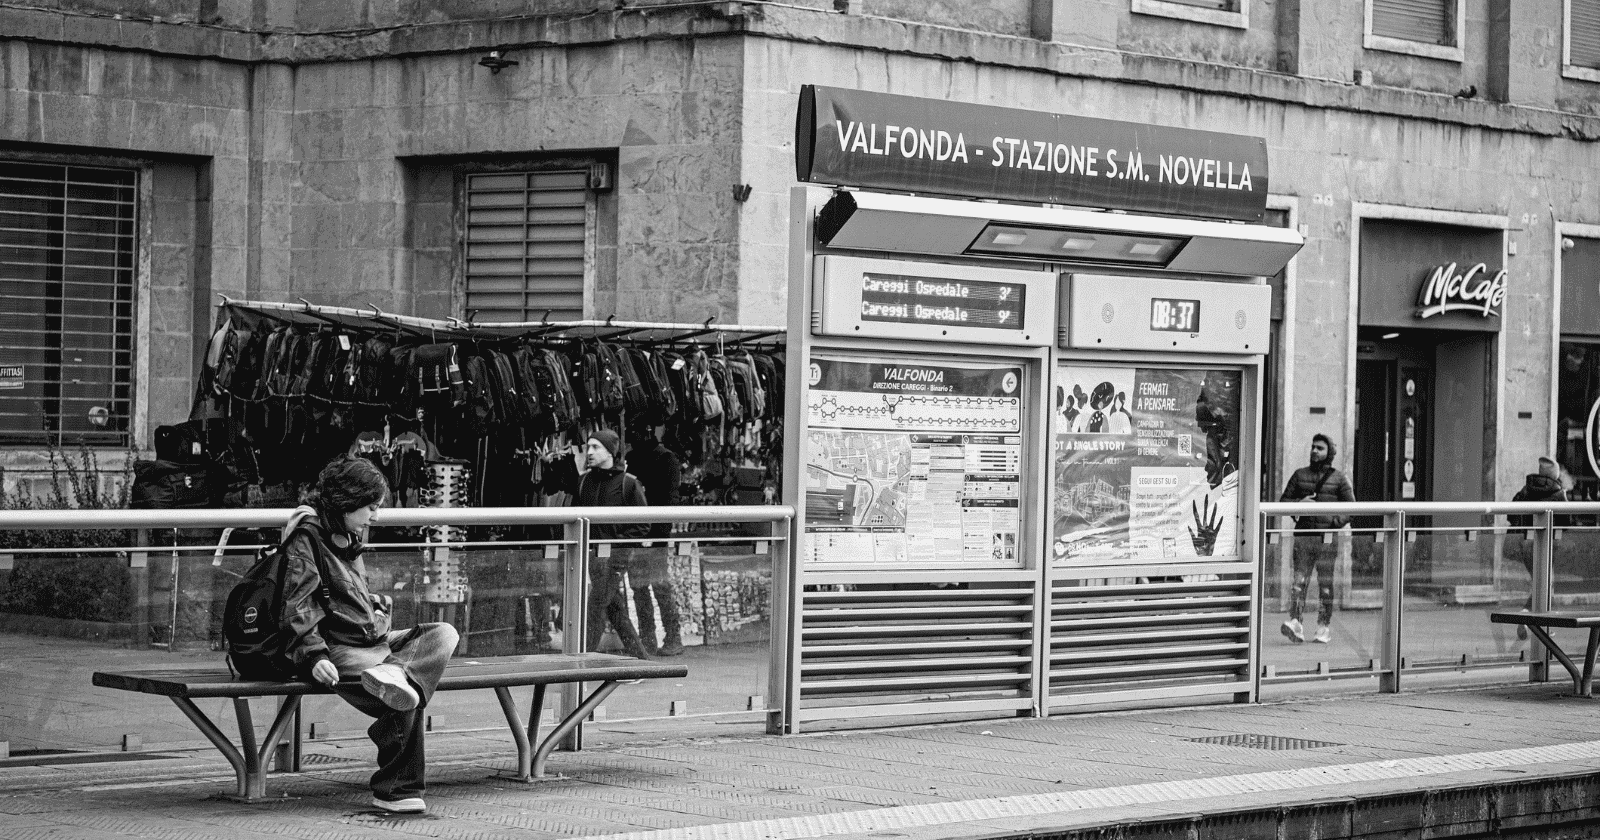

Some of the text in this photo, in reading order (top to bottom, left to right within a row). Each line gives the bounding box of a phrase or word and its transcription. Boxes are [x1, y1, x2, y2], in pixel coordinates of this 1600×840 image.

[836, 119, 968, 163] VALFONDA
[991, 136, 1098, 177] STAZIONE
[1105, 148, 1150, 182] S.M.
[1158, 155, 1253, 192] NOVELLA
[862, 277, 909, 293] Careggi
[916, 280, 969, 297] Ospedale
[1424, 262, 1508, 317] McCafé
[861, 301, 908, 317] Careggi
[914, 304, 968, 321] Ospedale
[1152, 300, 1194, 329] 08:37
[810, 367, 818, 378] T1
[884, 367, 944, 382] VALFONDA
[873, 382, 901, 390] DIREZIONE
[901, 383, 926, 391] CAREGGI
[1139, 382, 1169, 395] FERMATI
[1137, 397, 1181, 411] A PENSARE...
[1066, 441, 1072, 450] A
[1073, 441, 1098, 450] SINGLE
[1099, 441, 1126, 451] STORY
